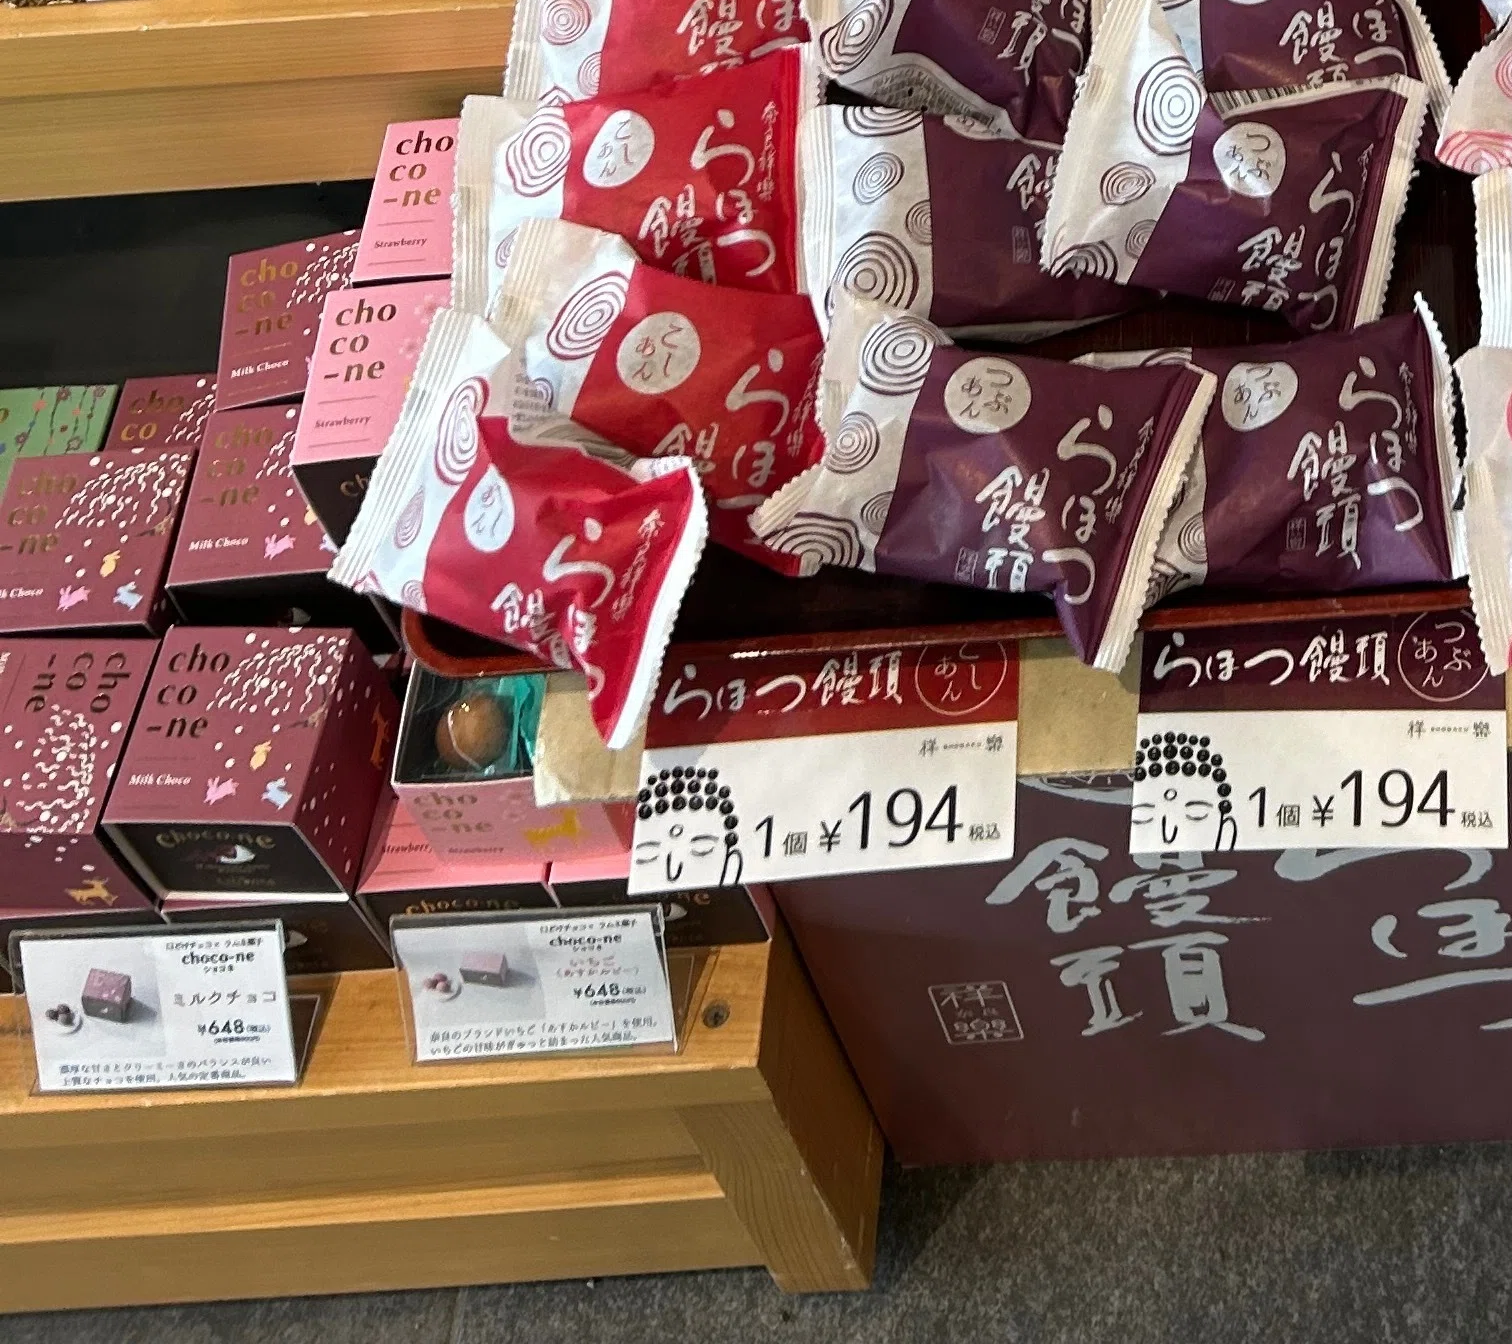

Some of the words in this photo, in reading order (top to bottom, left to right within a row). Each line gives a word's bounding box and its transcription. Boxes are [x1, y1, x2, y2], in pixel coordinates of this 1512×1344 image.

[396, 130, 455, 156] cho
[389, 162, 427, 183] co
[383, 186, 441, 208] -ne
[690, 108, 776, 277] らほつ
[374, 236, 428, 249] Strawberry
[1298, 151, 1355, 331] らほつ
[335, 298, 398, 327] cho
[329, 332, 370, 356] co
[230, 364, 255, 378] Milk
[256, 358, 289, 373] Choco
[323, 359, 386, 383] -ne
[120, 420, 158, 441] co
[315, 415, 372, 430] Strawberry
[1338, 356, 1425, 532] らほつ
[1041, 404, 1120, 604] らほつ
[1285, 420, 1363, 569] 饅頭
[975, 465, 1050, 592] 饅頭
[168, 642, 231, 674] cho
[1152, 629, 1391, 689] らほつ饅頭
[1434, 620, 1473, 673] つぶ
[1411, 635, 1445, 689] あん
[90, 652, 132, 714] cho
[662, 650, 905, 721] らほつ饅頭
[934, 656, 962, 703] あん
[157, 681, 199, 706] co
[145, 715, 209, 739] -ne
[128, 771, 155, 787] Milk
[156, 771, 192, 786] Choco
[1247, 785, 1301, 830] 1個
[1311, 768, 1456, 830] ¥194
[754, 814, 809, 859] 1個
[818, 783, 964, 854] ¥194
[181, 950, 256, 966] choco-ne
[173, 989, 277, 1007] ミルクチョコ
[573, 983, 621, 1000] ¥648
[197, 1018, 244, 1036] ¥648
